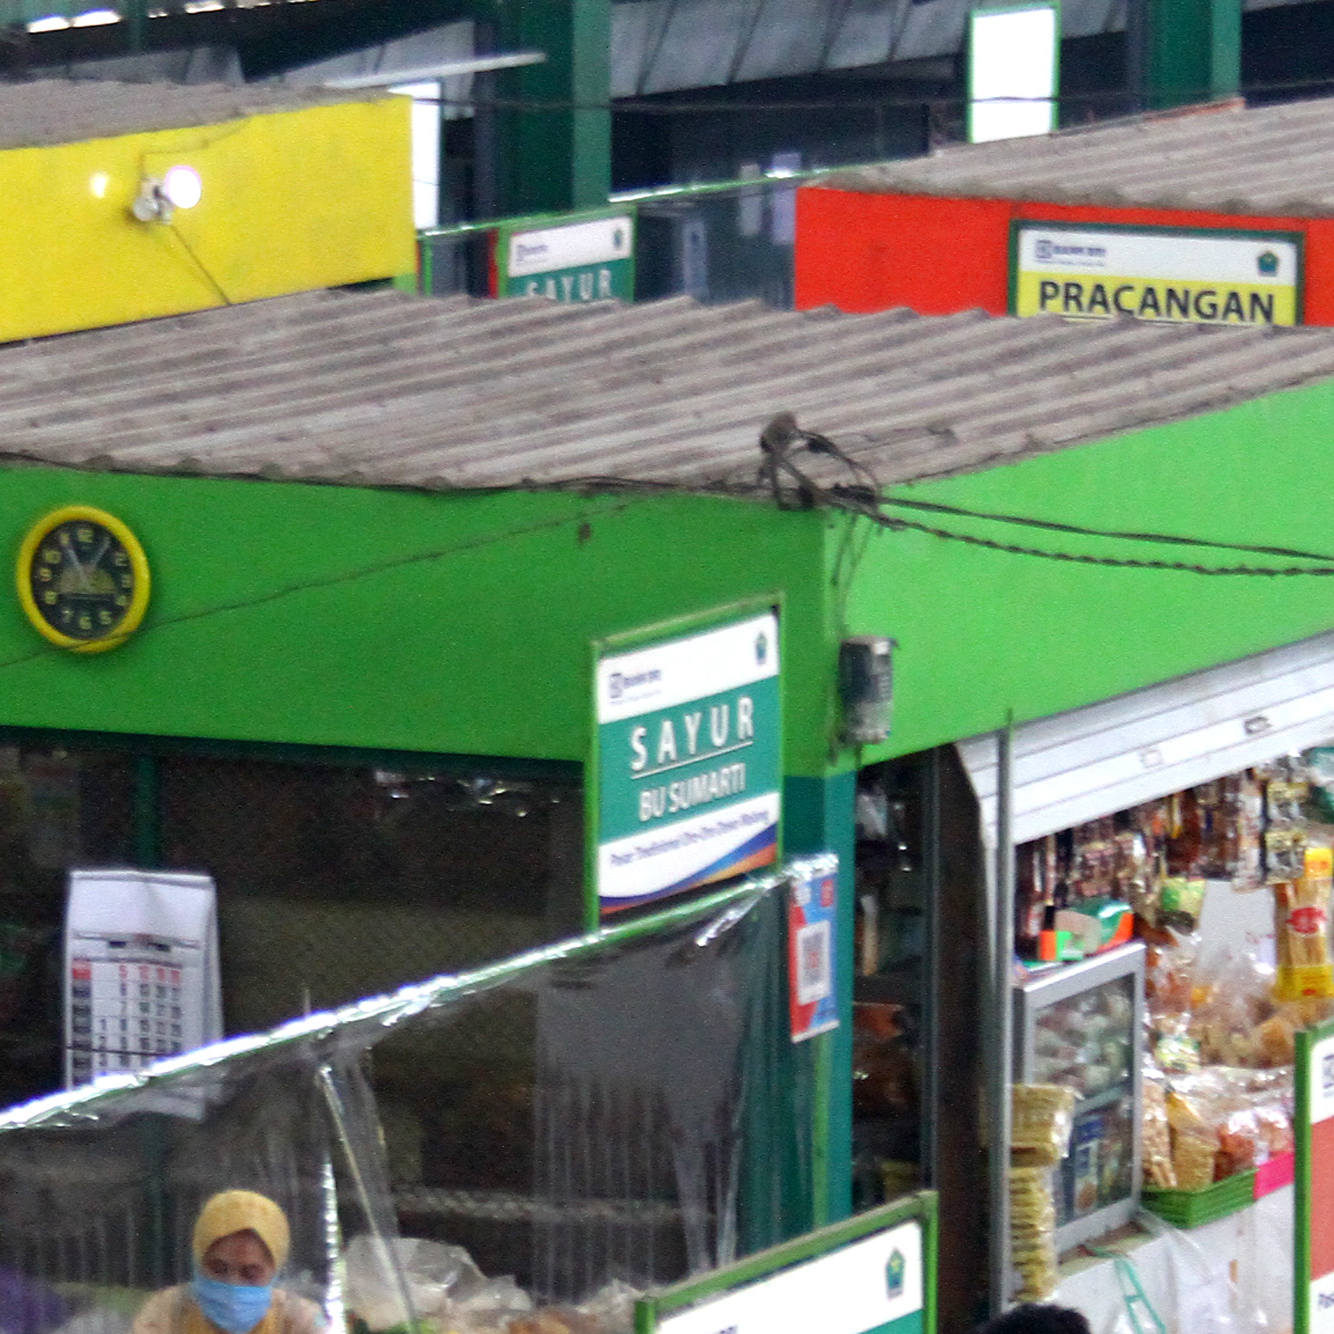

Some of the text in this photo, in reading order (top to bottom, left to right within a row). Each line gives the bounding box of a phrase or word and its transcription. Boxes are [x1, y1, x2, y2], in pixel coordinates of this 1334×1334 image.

[1039, 280, 1274, 323] PRACANGAN
[631, 696, 754, 771] SAYUR
[640, 762, 746, 822] BU SUMARTI
